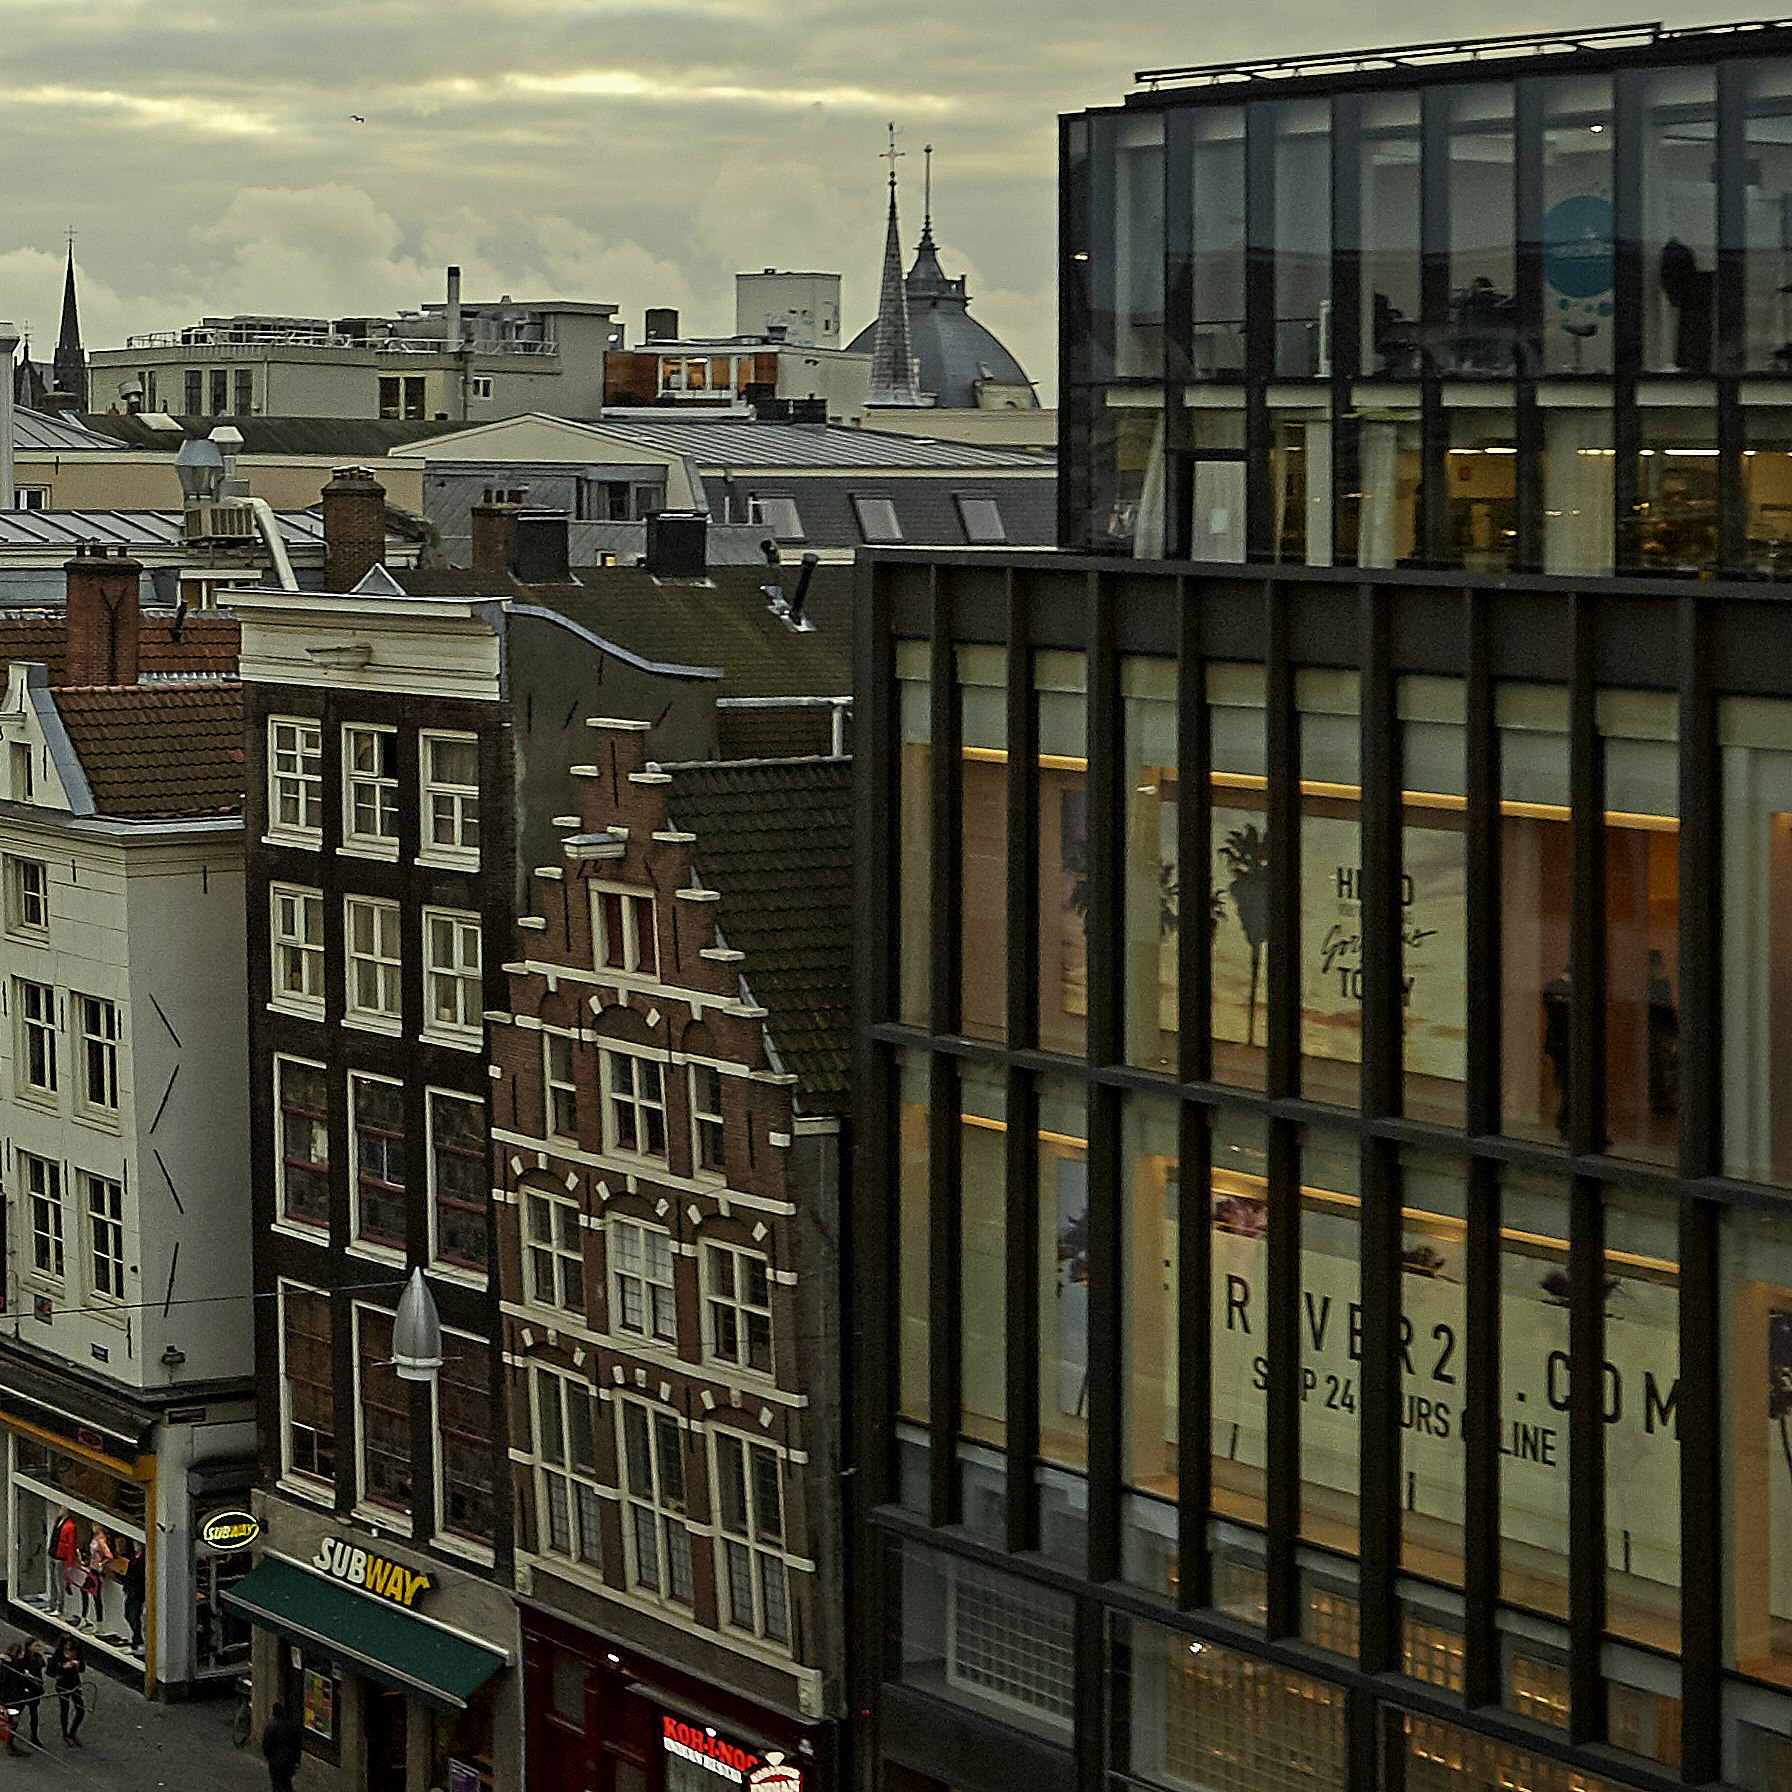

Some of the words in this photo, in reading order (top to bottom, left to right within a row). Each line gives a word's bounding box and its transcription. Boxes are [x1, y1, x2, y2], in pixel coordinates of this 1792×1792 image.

[1253, 1356, 1317, 1402] SP
[1326, 1374, 1356, 1414] 24
[205, 1523, 258, 1541] SUBWAY
[312, 1536, 430, 1606] SUBWAY
